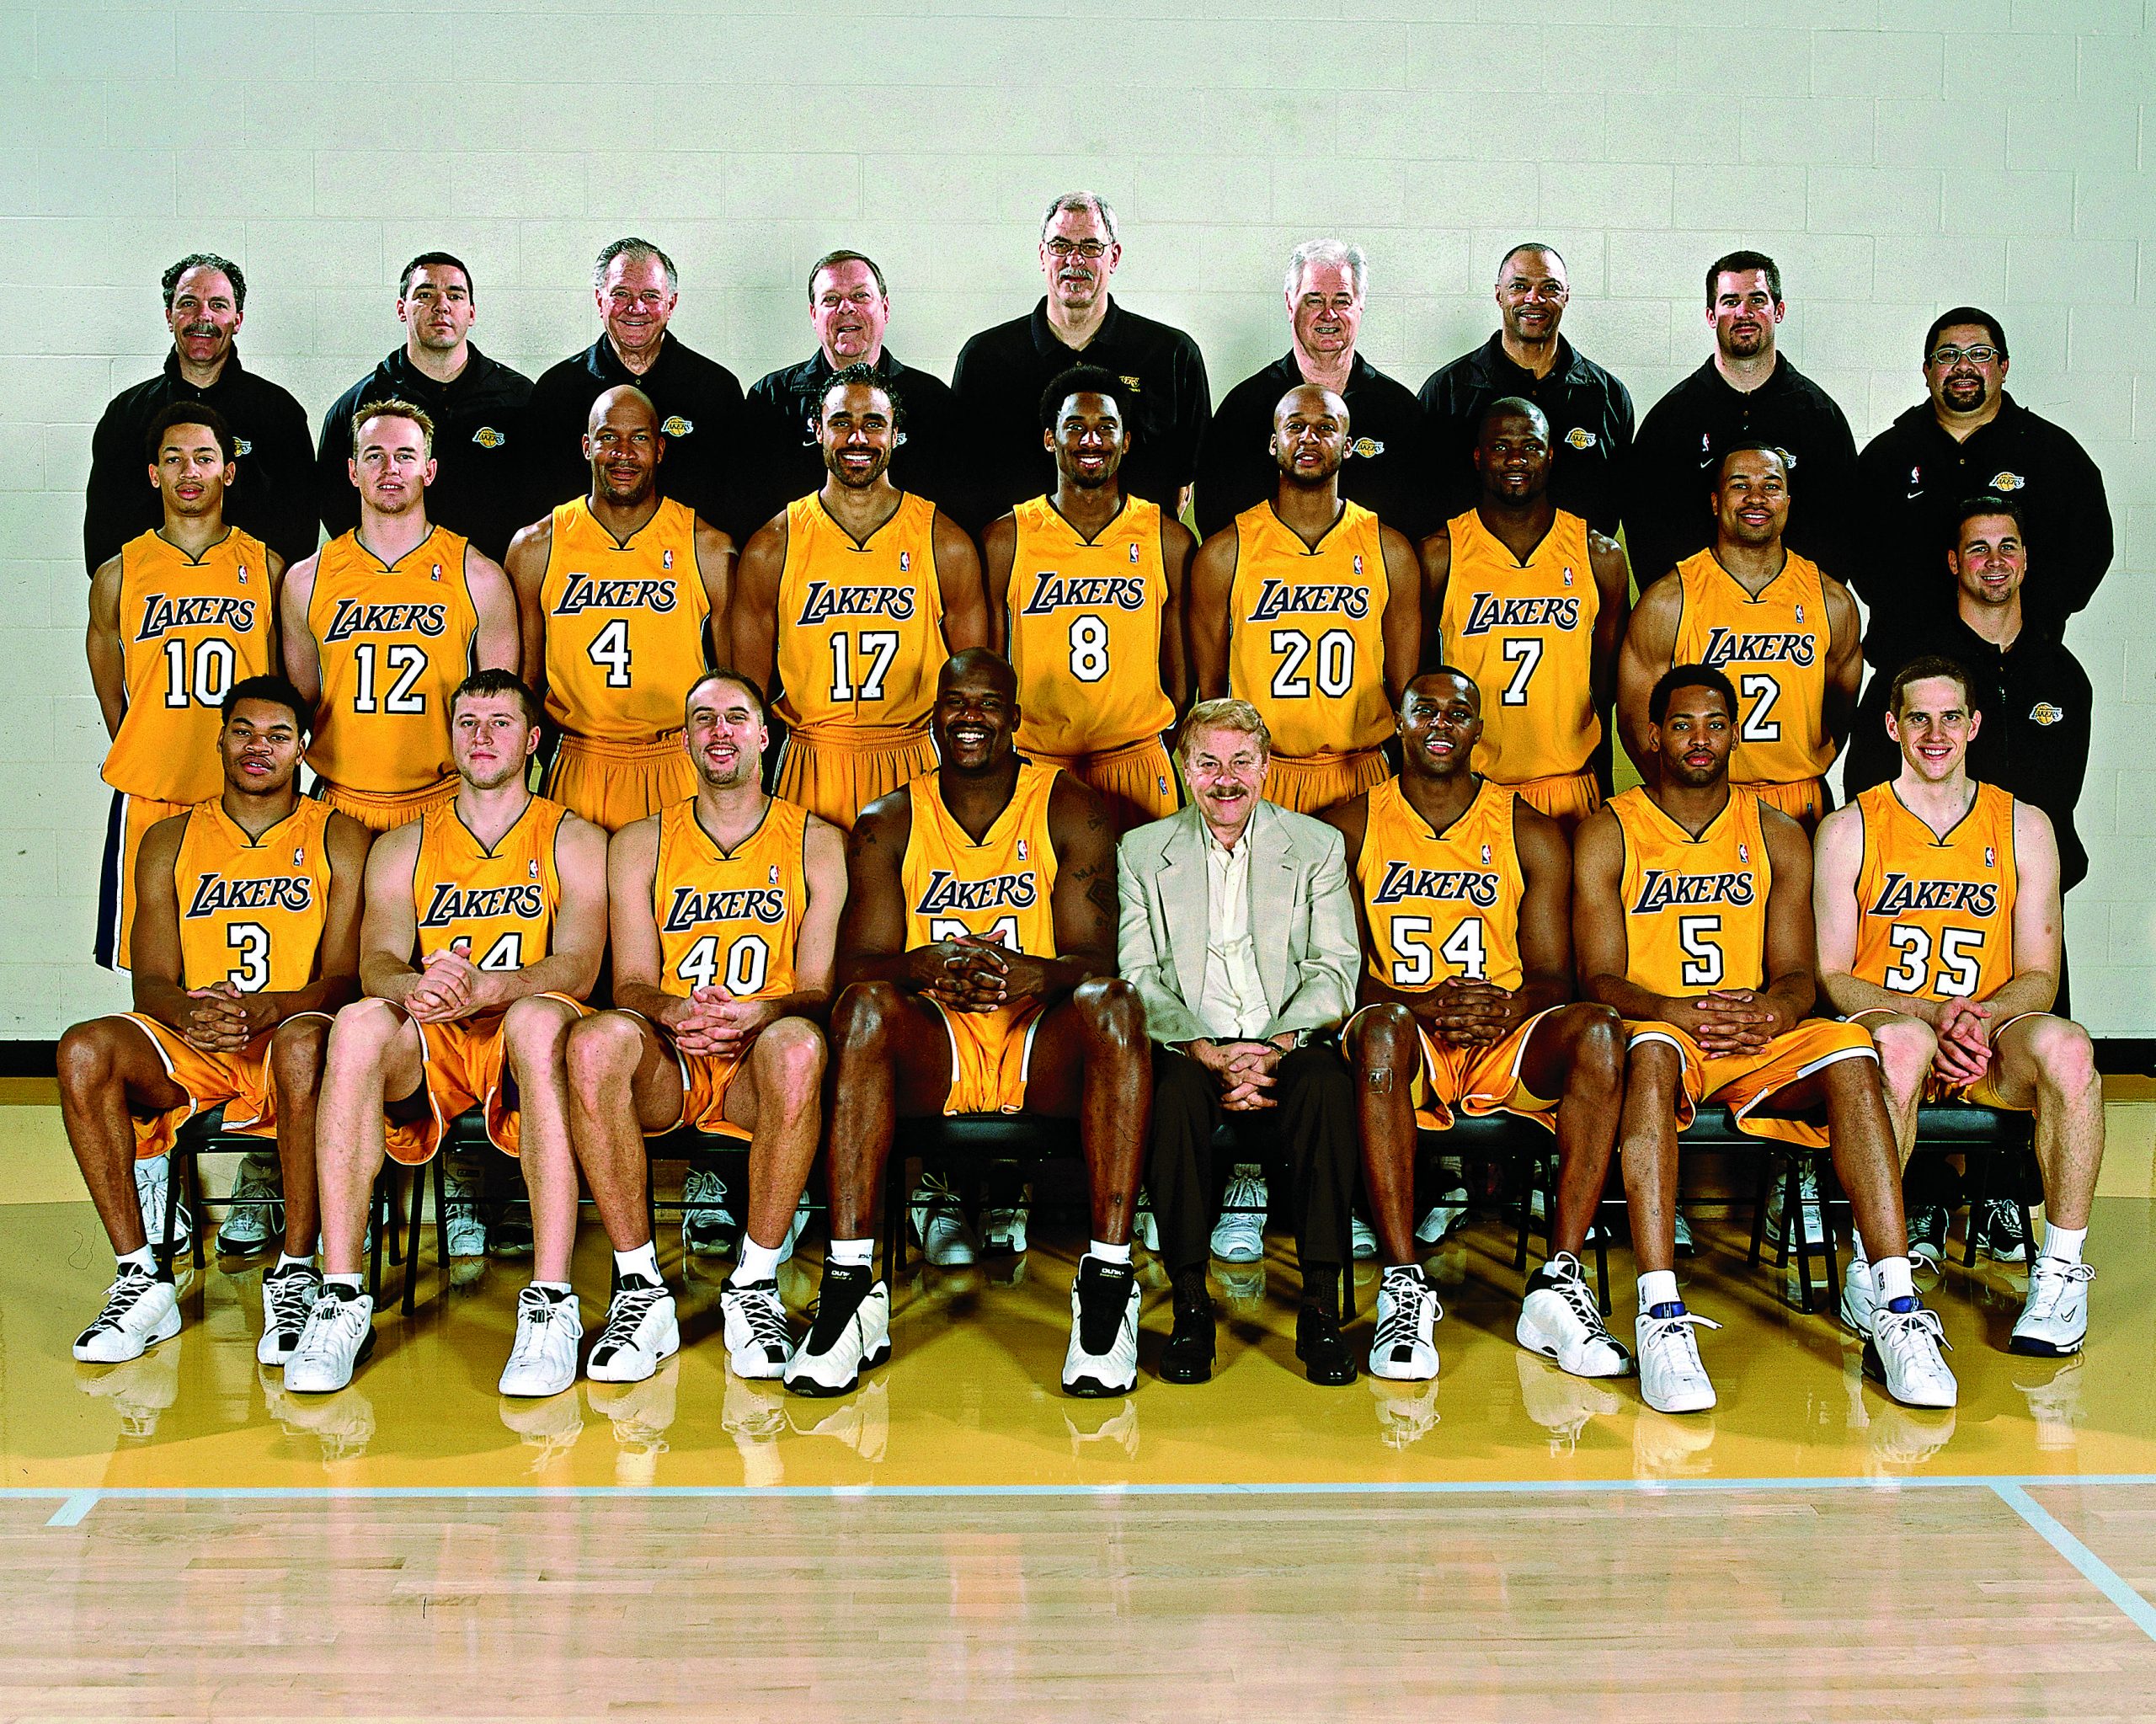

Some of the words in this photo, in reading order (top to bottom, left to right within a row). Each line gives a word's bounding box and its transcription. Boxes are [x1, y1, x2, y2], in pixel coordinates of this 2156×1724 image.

[472, 430, 504, 446] LAKERS
[661, 418, 694, 434] LAKERS
[1352, 438, 1384, 456] LAKERS
[1565, 430, 1596, 446] LAKERS
[1988, 474, 2025, 489] LAKERS
[551, 572, 678, 616] LAKERS
[796, 580, 915, 626] LAKERS
[1022, 571, 1145, 616] LAKERS
[1246, 578, 1370, 623] LAKERS
[1461, 591, 1580, 638] LAKERS
[134, 593, 257, 643] LAKERS
[323, 598, 448, 644] LAKERS
[587, 619, 632, 688] 4
[830, 631, 899, 702] 17
[1069, 615, 1109, 683] 8
[1271, 629, 1355, 699] 20
[1700, 627, 1816, 670] LAKERS
[164, 638, 236, 708] 10
[354, 643, 428, 714] 12
[1502, 638, 1543, 707] 7
[1741, 674, 1780, 742] 2
[2029, 705, 2063, 722] LAKERS
[184, 872, 312, 920] LAKERS
[417, 883, 545, 928] LAKERS
[914, 869, 1038, 915] LAKERS
[1371, 860, 1499, 908] LAKERS
[1630, 868, 1756, 915] LAKERS
[1866, 872, 1999, 918] LAKERS
[661, 886, 786, 934] LAKERS
[227, 921, 270, 993] 3
[449, 931, 525, 970] 4
[676, 935, 769, 996] 40
[1390, 915, 1486, 987] 54
[1679, 915, 1724, 986] 5
[1883, 923, 1985, 996] 35
